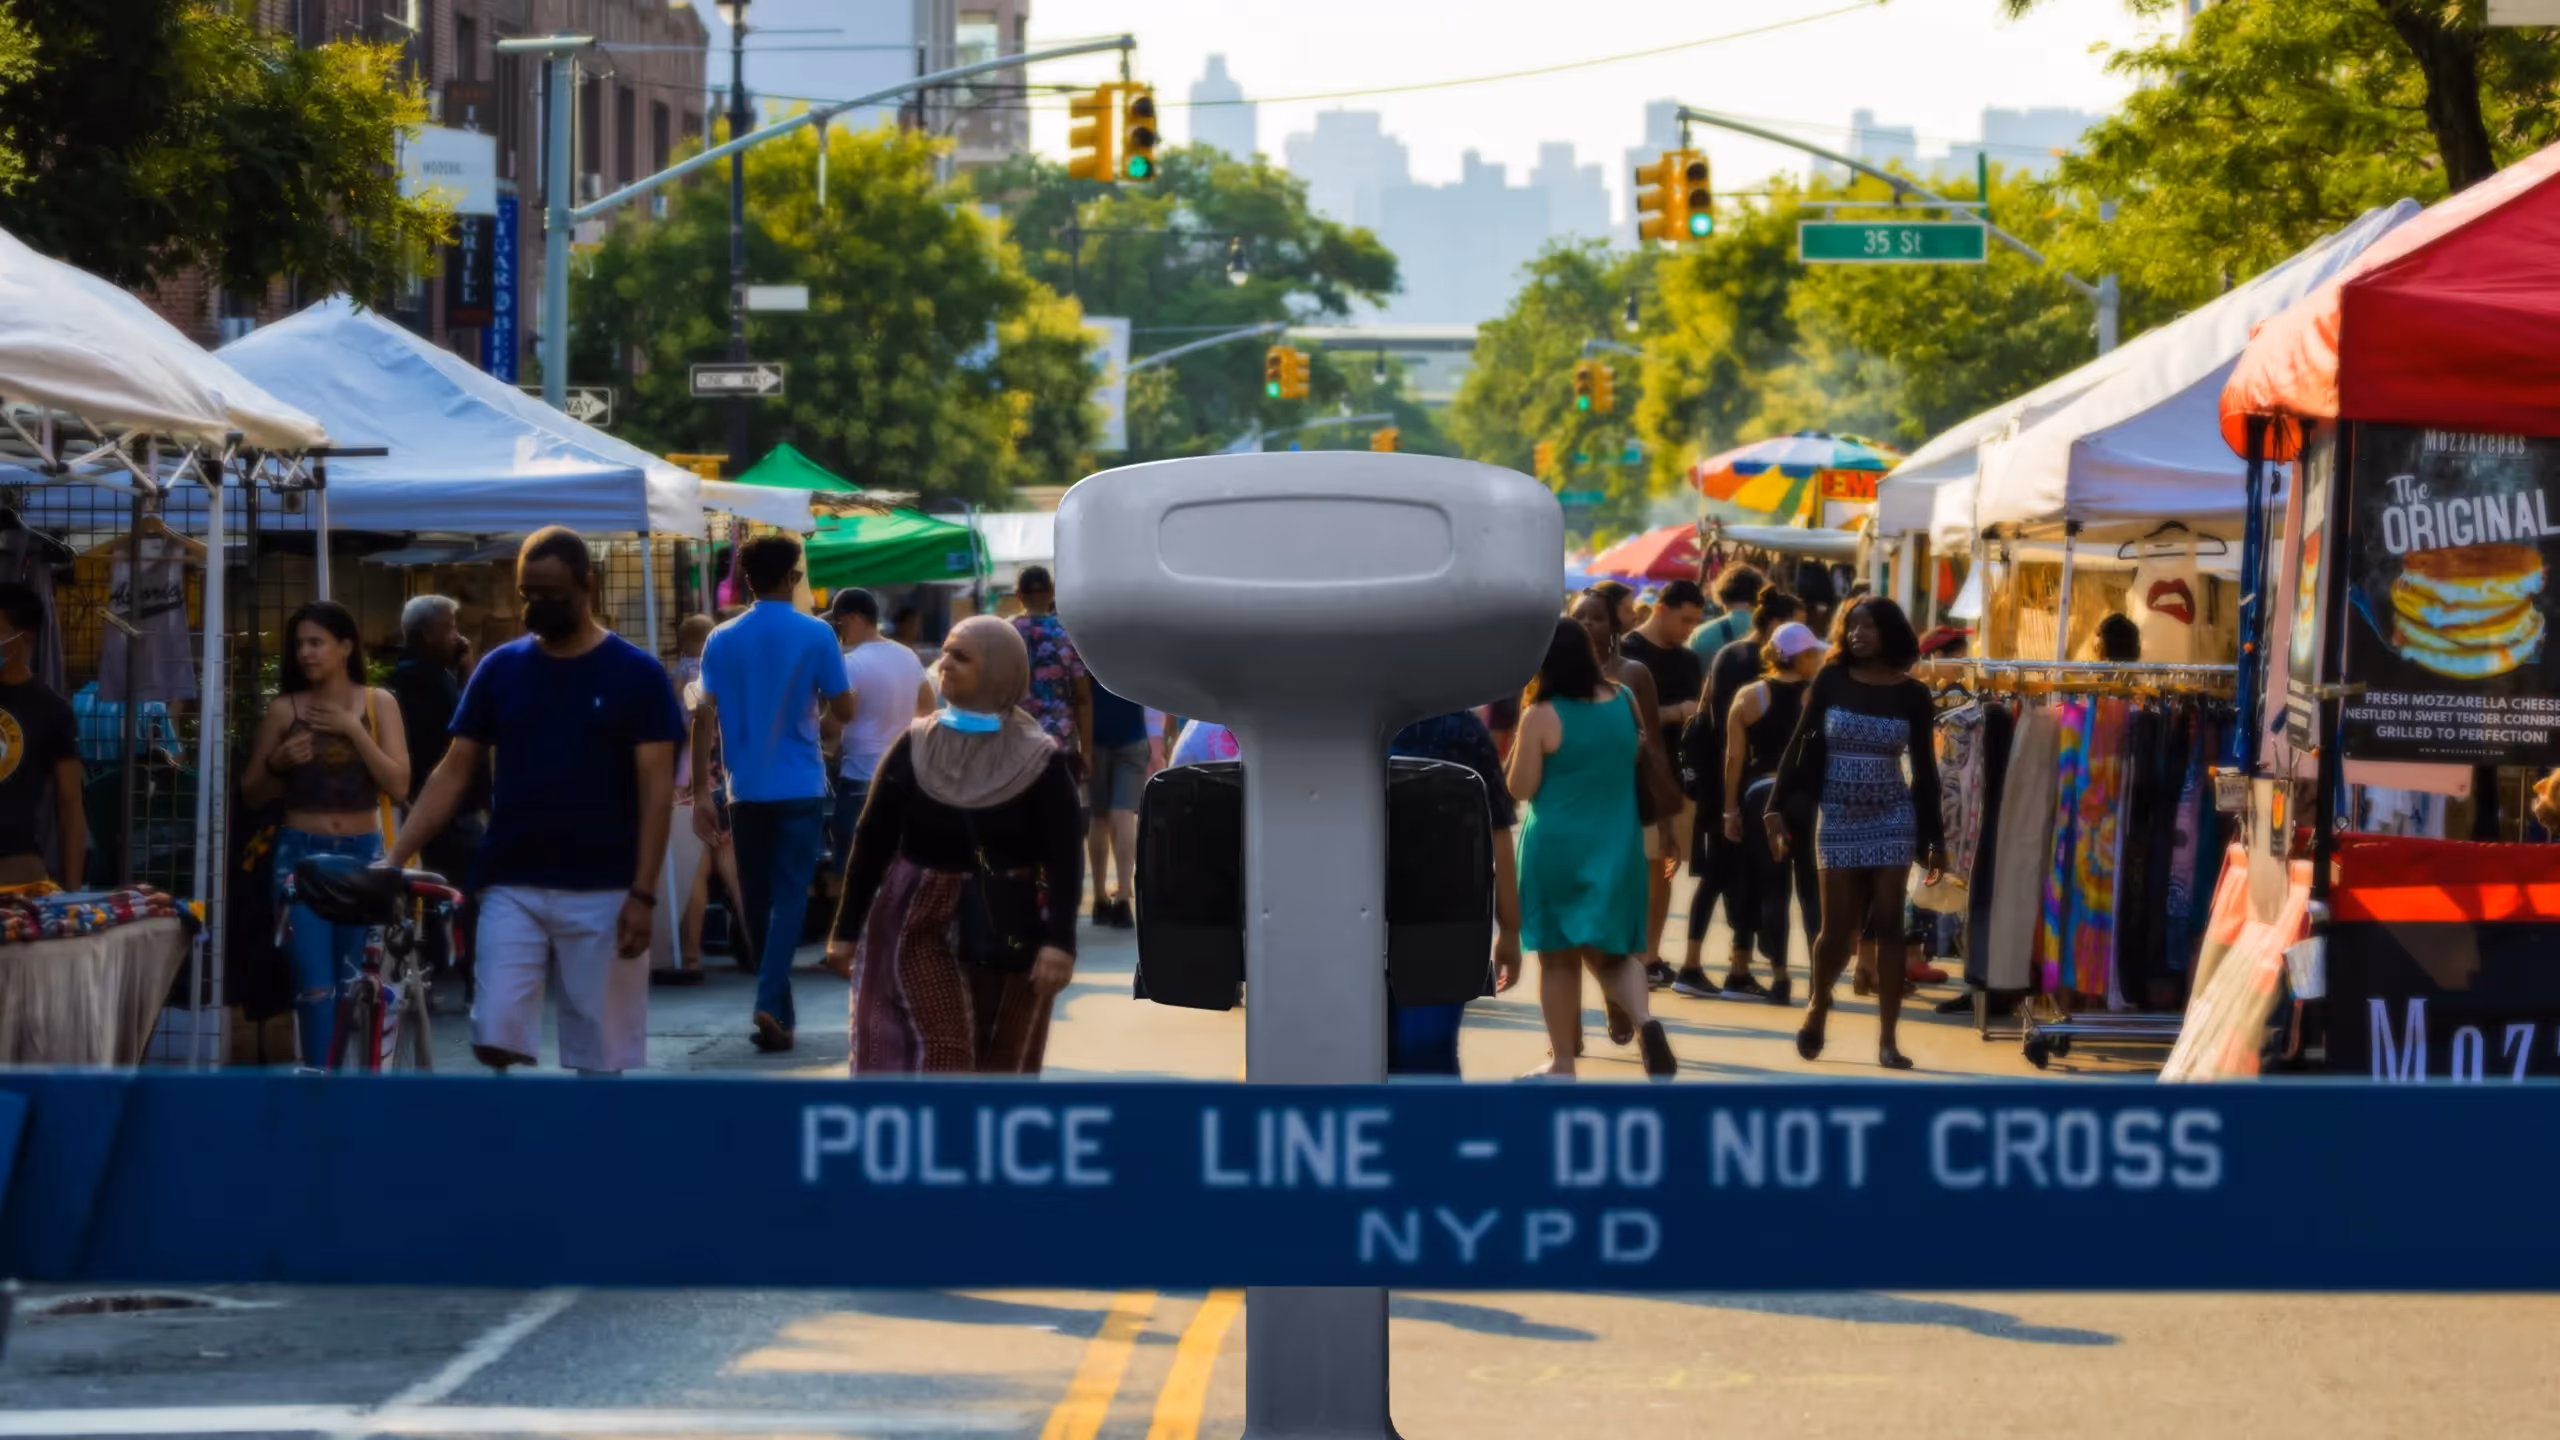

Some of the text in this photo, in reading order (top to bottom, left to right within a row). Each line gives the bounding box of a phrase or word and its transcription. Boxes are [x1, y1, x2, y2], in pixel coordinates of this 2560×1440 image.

[1863, 229, 1922, 255] 35 St
[461, 217, 479, 304] GRILL
[699, 373, 771, 387] ONE WAY
[1822, 470, 1880, 498] EM
[2385, 474, 2431, 507] The
[2382, 488, 2560, 556] ORIGINAL
[2364, 692, 2560, 712] FRESH MOZZARELLA CHEESE
[2345, 707, 2560, 728] NESTLED IN SWEET TENDER CORNBRE
[2376, 725, 2549, 744] GRILLED TO PERFECTION!
[2367, 997, 2560, 1083] Moz
[802, 1106, 2223, 1190] POLICE LINE - DO NOT CROSS
[1358, 1208, 1661, 1264] NYPD
